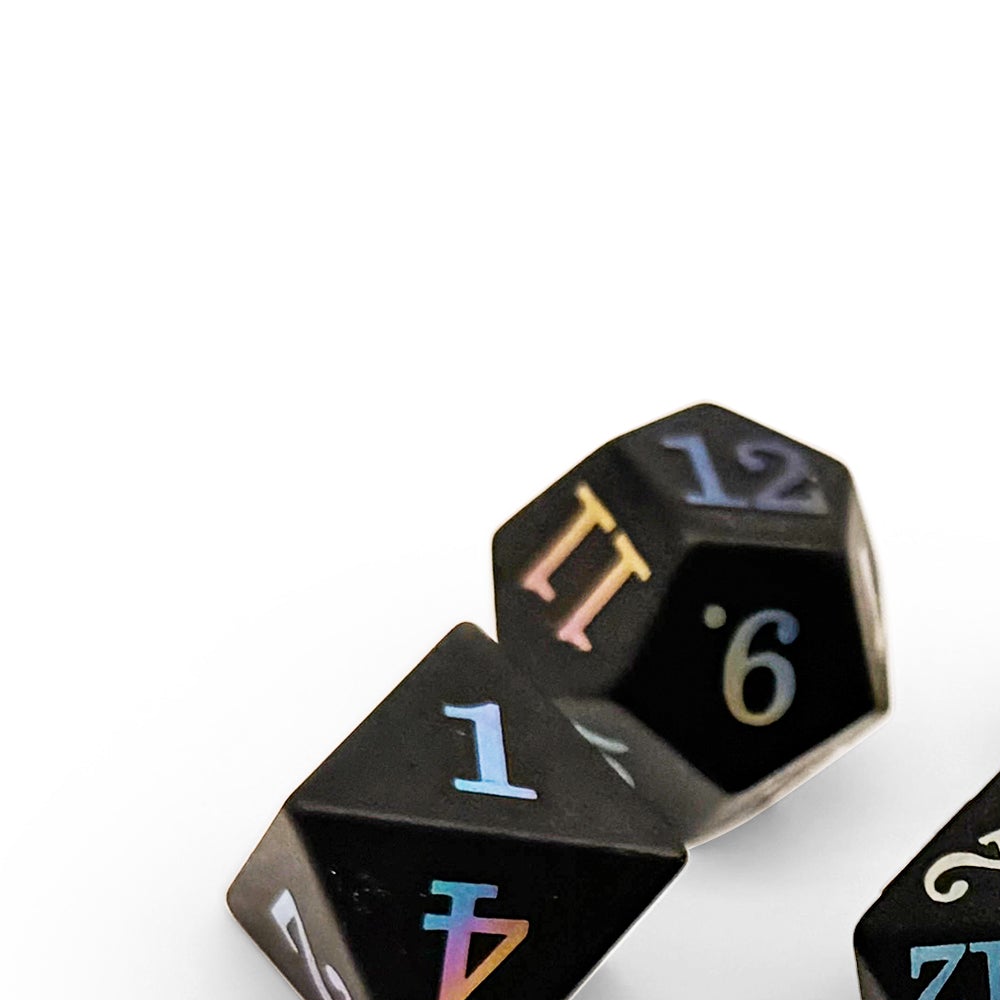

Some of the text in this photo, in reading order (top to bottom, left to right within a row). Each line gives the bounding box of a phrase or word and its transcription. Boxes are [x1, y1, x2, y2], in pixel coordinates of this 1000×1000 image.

[662, 436, 829, 514] 12
[520, 482, 651, 652] 11
[444, 703, 538, 801] 1
